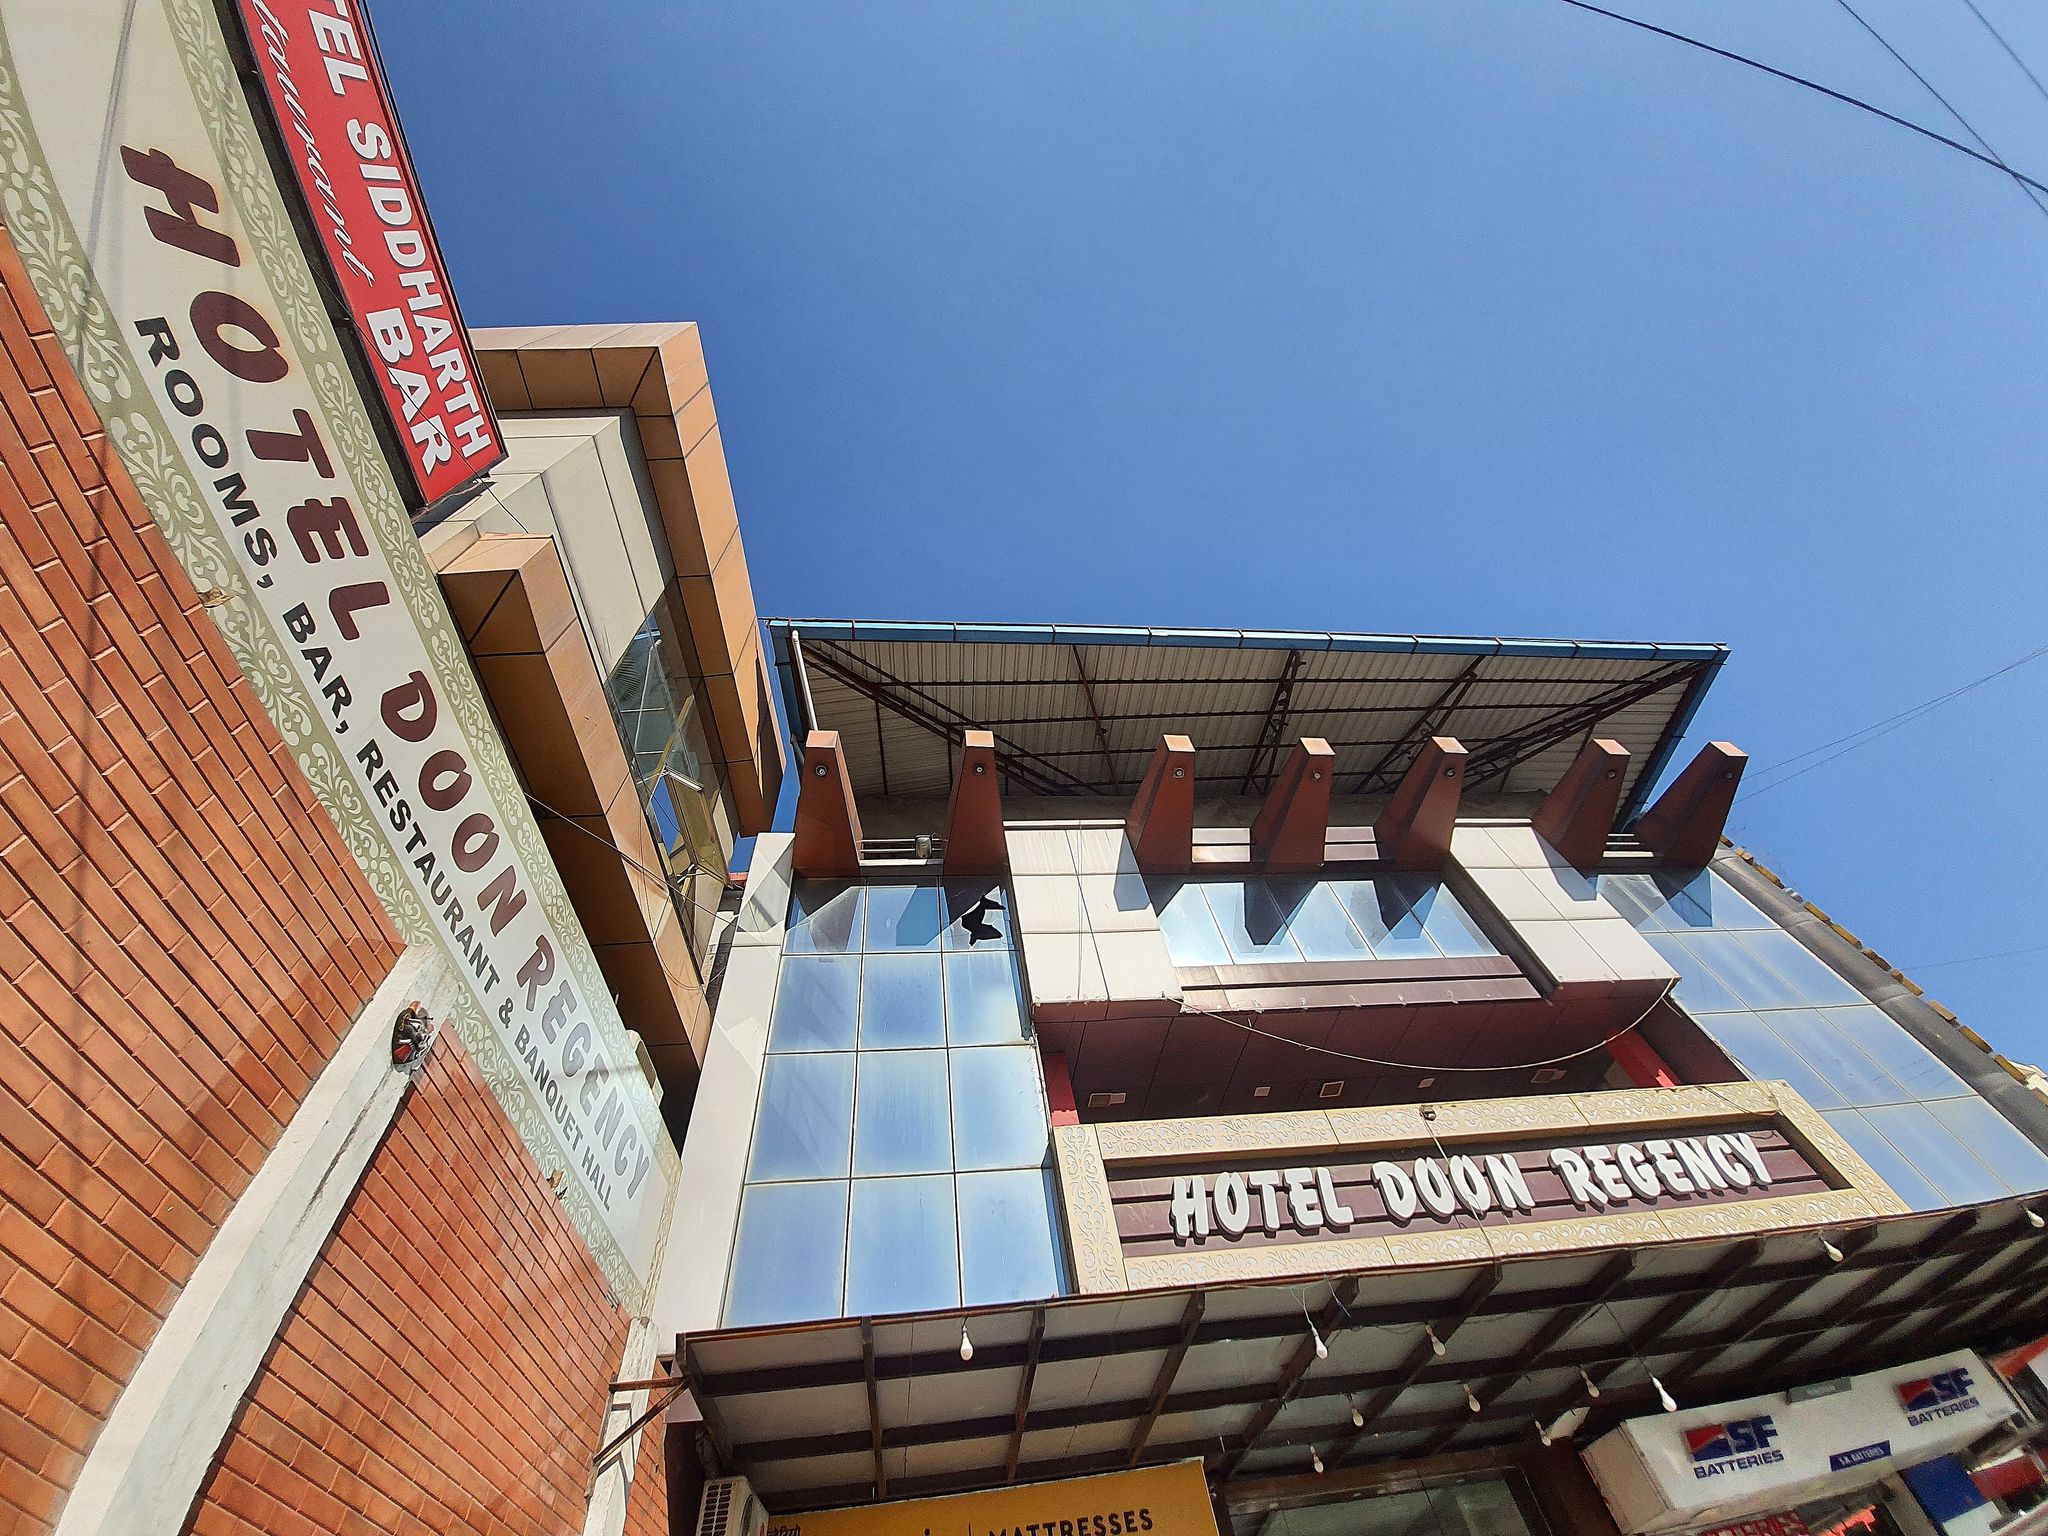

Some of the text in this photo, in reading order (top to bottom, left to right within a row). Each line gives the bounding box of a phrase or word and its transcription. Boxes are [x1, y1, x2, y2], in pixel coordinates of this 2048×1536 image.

[346, 118, 491, 459] SIDDHARTH
[366, 307, 453, 477] BAR
[120, 144, 651, 1200] HOTEL DOON REGENCY
[134, 315, 612, 1212] ROOMS, BAR, RESTAURANT & BANQUET HALL
[1171, 1132, 1774, 1244] HOTEL DOON REGENCY
[1726, 1415, 1779, 1454] SF
[1907, 1397, 1981, 1427] BATTERIES
[1931, 1367, 1974, 1402] SF
[1693, 1449, 1785, 1479] BATTERIES
